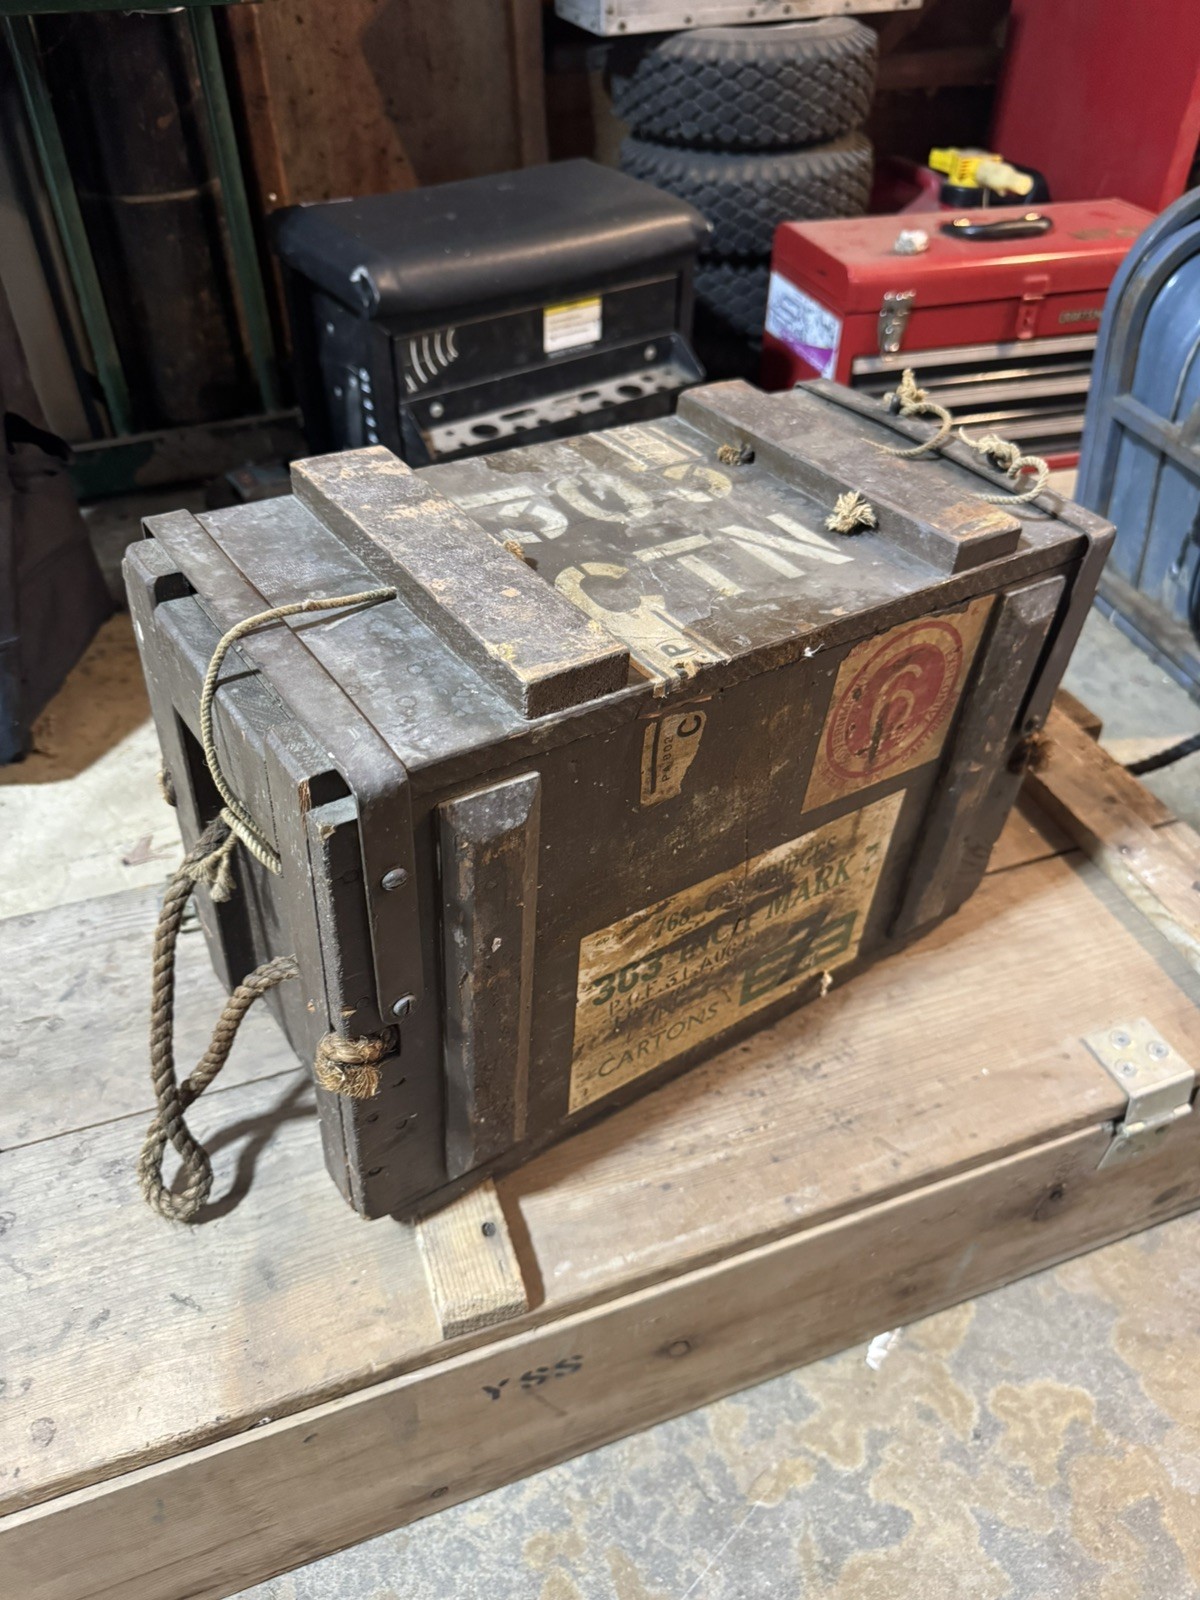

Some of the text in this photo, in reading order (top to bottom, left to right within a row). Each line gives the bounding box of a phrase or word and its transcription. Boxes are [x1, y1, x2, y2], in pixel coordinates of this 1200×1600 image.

[554, 513, 855, 616] CTN
[677, 714, 702, 738] C
[765, 854, 856, 919] MARK
[656, 906, 691, 940] 768
[597, 1002, 720, 1078] CARTONS
